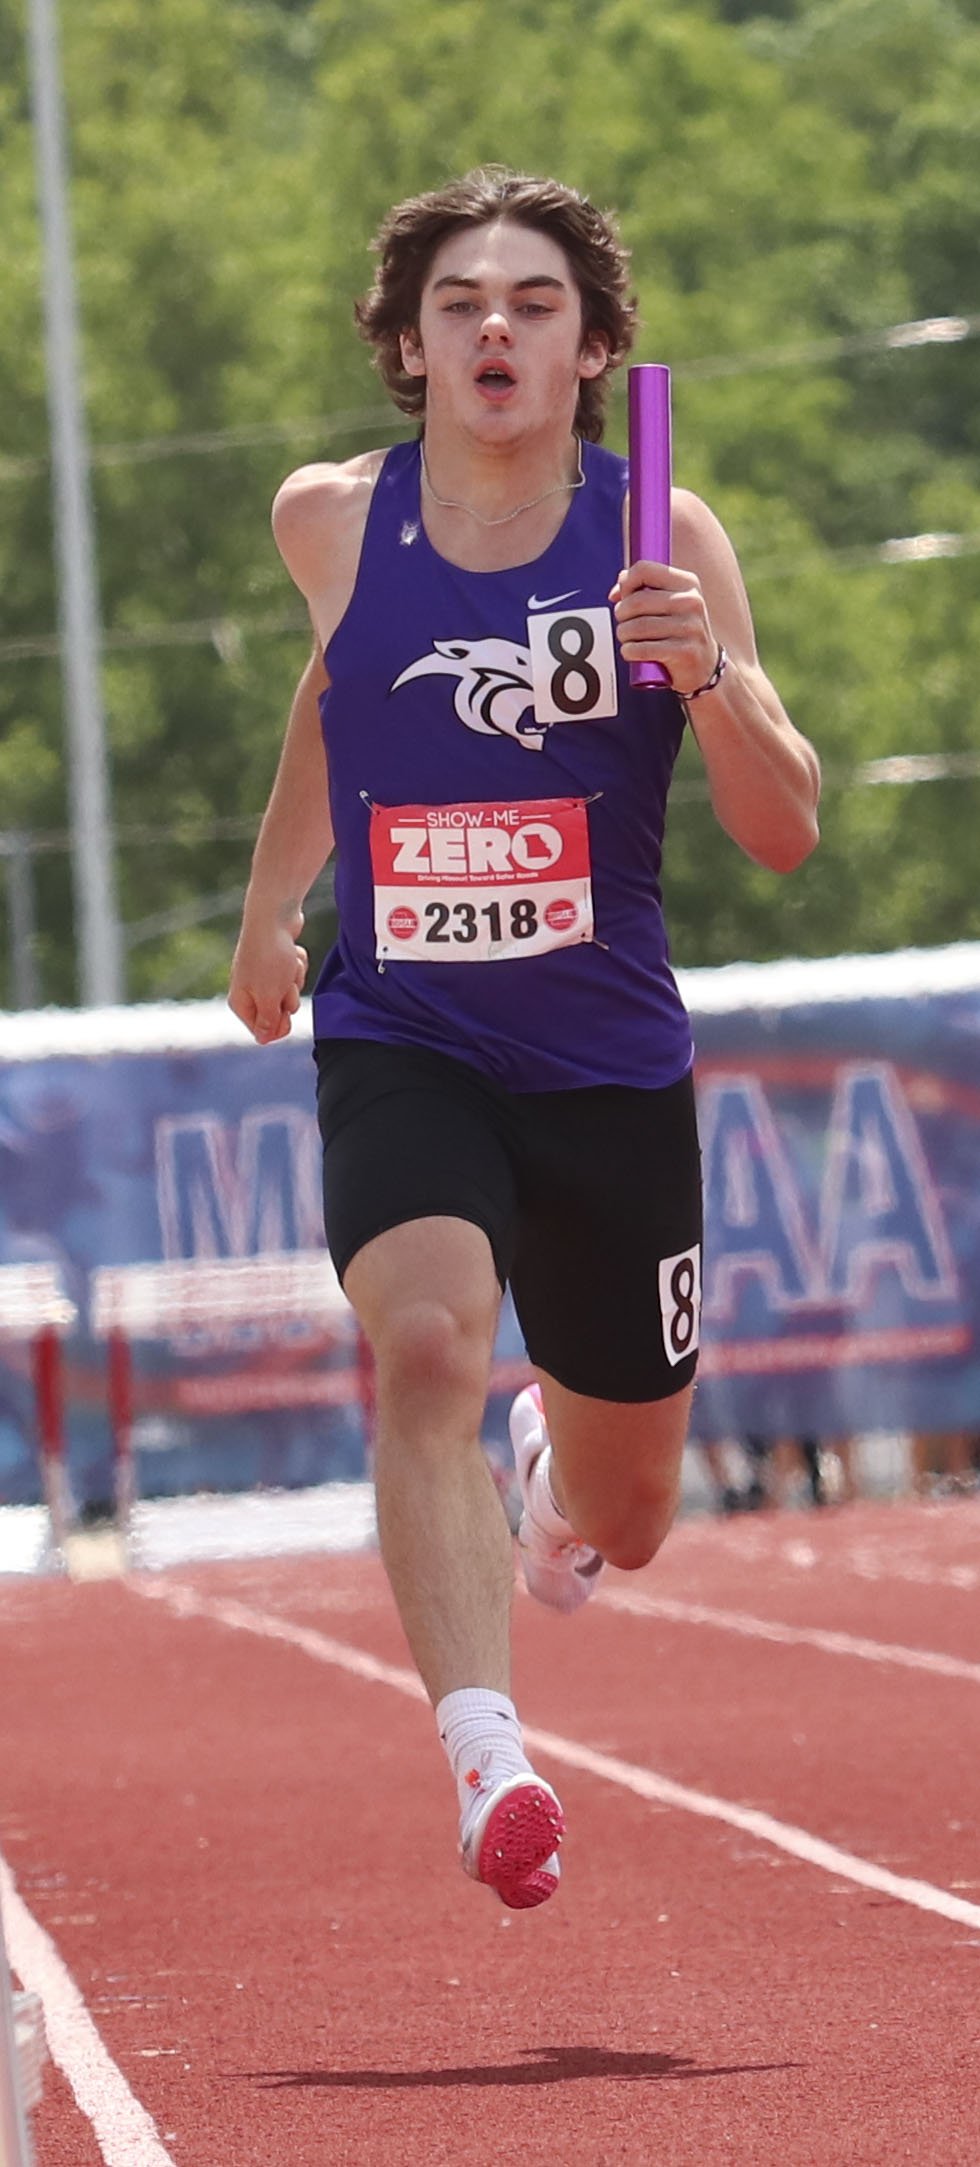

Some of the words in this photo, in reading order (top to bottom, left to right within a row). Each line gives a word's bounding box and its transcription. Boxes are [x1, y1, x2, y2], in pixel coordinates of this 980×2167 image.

[547, 616, 601, 715] 8
[426, 810, 520, 828] SHOW-ME
[390, 822, 563, 874] ZERO
[424, 898, 538, 944] 2318
[670, 1261, 694, 1354] 8
